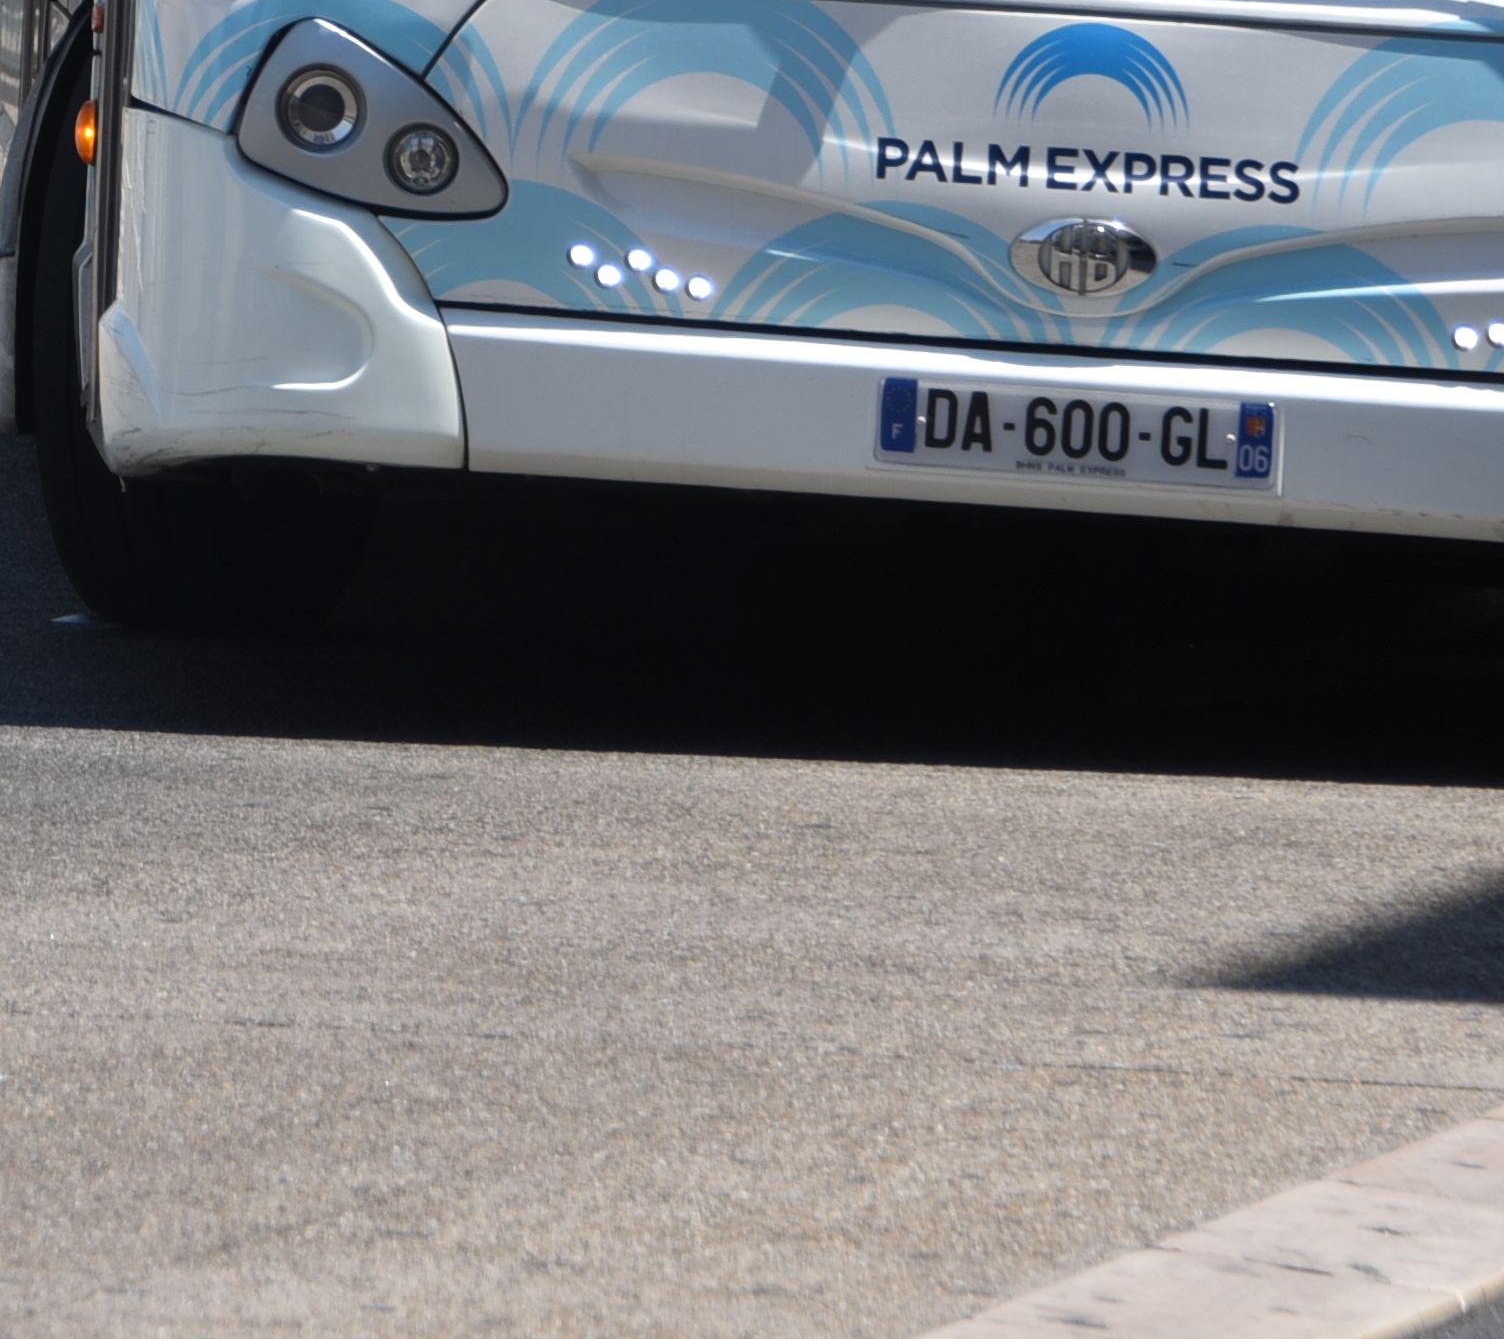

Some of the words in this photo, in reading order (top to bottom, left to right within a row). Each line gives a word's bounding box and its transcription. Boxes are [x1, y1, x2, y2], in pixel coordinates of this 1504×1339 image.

[874, 136, 1031, 188] PALM
[1045, 146, 1301, 205] EXPRESS
[891, 422, 904, 440] F
[923, 387, 1229, 470] DA-600-GL
[1238, 443, 1270, 473] 06
